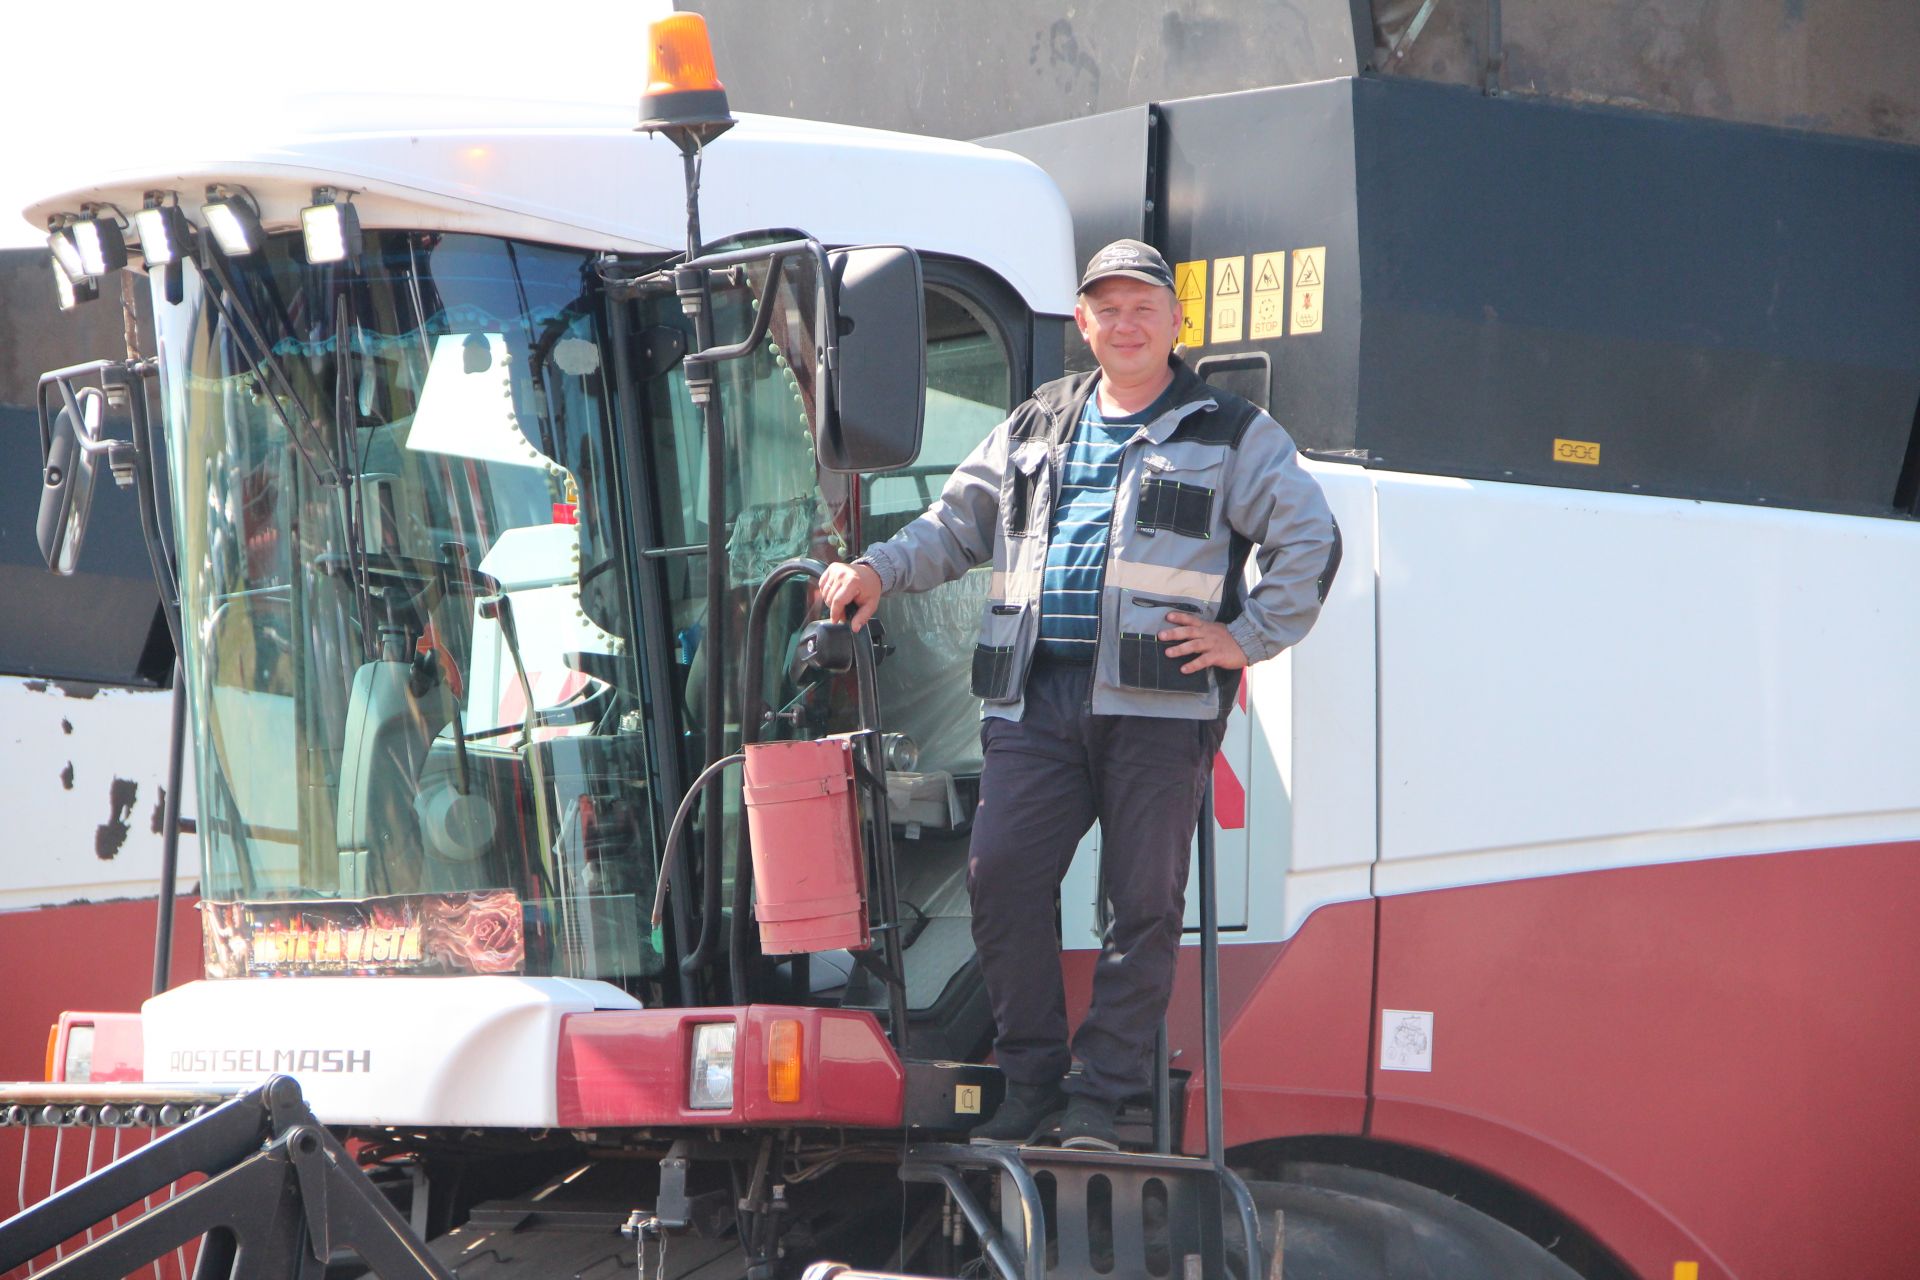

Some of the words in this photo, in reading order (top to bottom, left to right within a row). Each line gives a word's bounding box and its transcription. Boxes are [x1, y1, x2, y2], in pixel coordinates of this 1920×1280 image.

[1255, 320, 1278, 333] STOP
[314, 928, 341, 962] LA
[346, 926, 423, 962] VISTA
[170, 1049, 371, 1073] ROSTSELMASH
